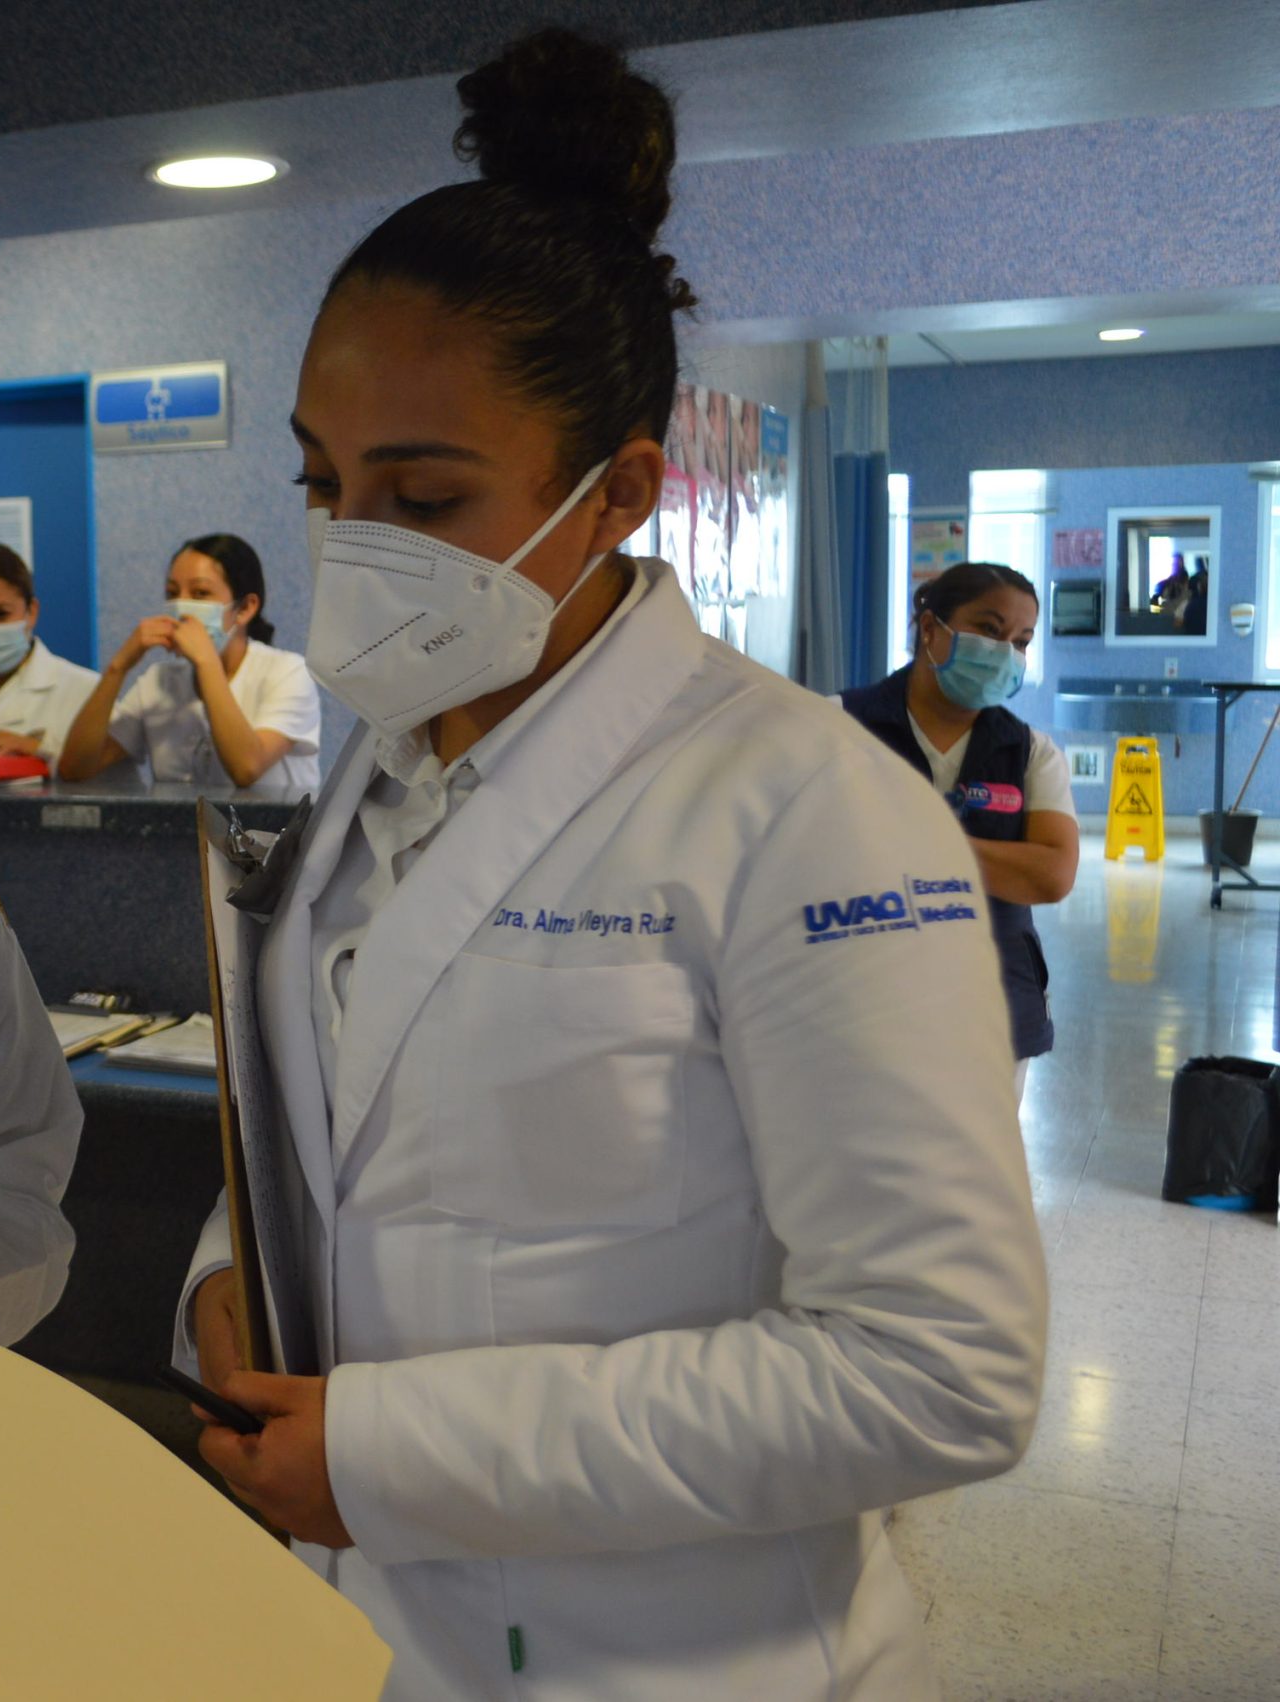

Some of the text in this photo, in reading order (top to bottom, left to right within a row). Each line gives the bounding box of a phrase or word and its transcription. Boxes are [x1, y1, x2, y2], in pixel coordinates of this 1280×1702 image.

[420, 623, 464, 655] KN95
[493, 908, 528, 929] Dra.
[803, 889, 906, 932] UVAQ
